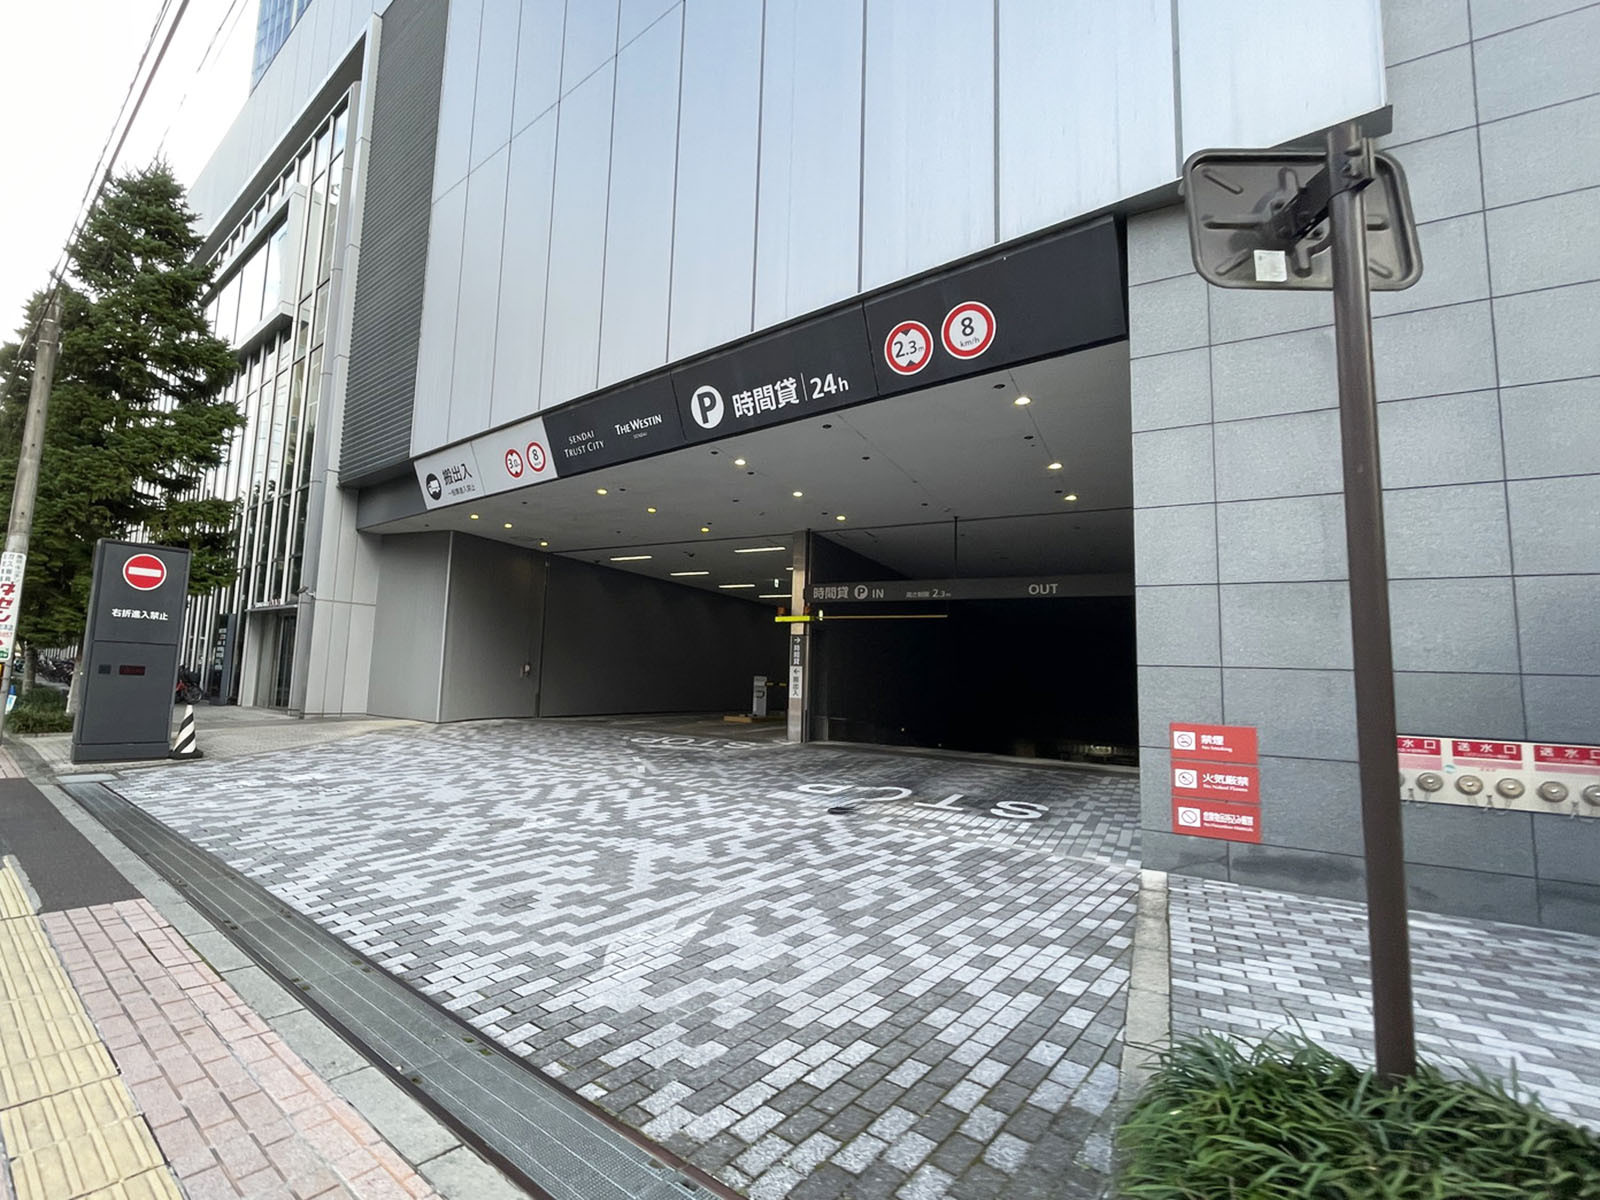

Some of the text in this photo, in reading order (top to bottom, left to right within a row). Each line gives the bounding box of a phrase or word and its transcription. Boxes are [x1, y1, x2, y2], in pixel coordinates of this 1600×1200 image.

[961, 317, 974, 336] 8
[960, 337, 980, 348] km/h
[694, 373, 849, 427] P 時間貸 24h
[629, 414, 662, 431] WESTIN
[568, 430, 595, 444] SENDAI
[532, 449, 539, 461] 8
[564, 440, 605, 458] TRUST CITY
[442, 463, 472, 485] 搬出入
[813, 586, 849, 599] 時間貸
[872, 589, 884, 598] IN
[1029, 584, 1058, 594] OUT
[111, 608, 168, 620] 右折進入禁止
[1402, 739, 1436, 749] 水口
